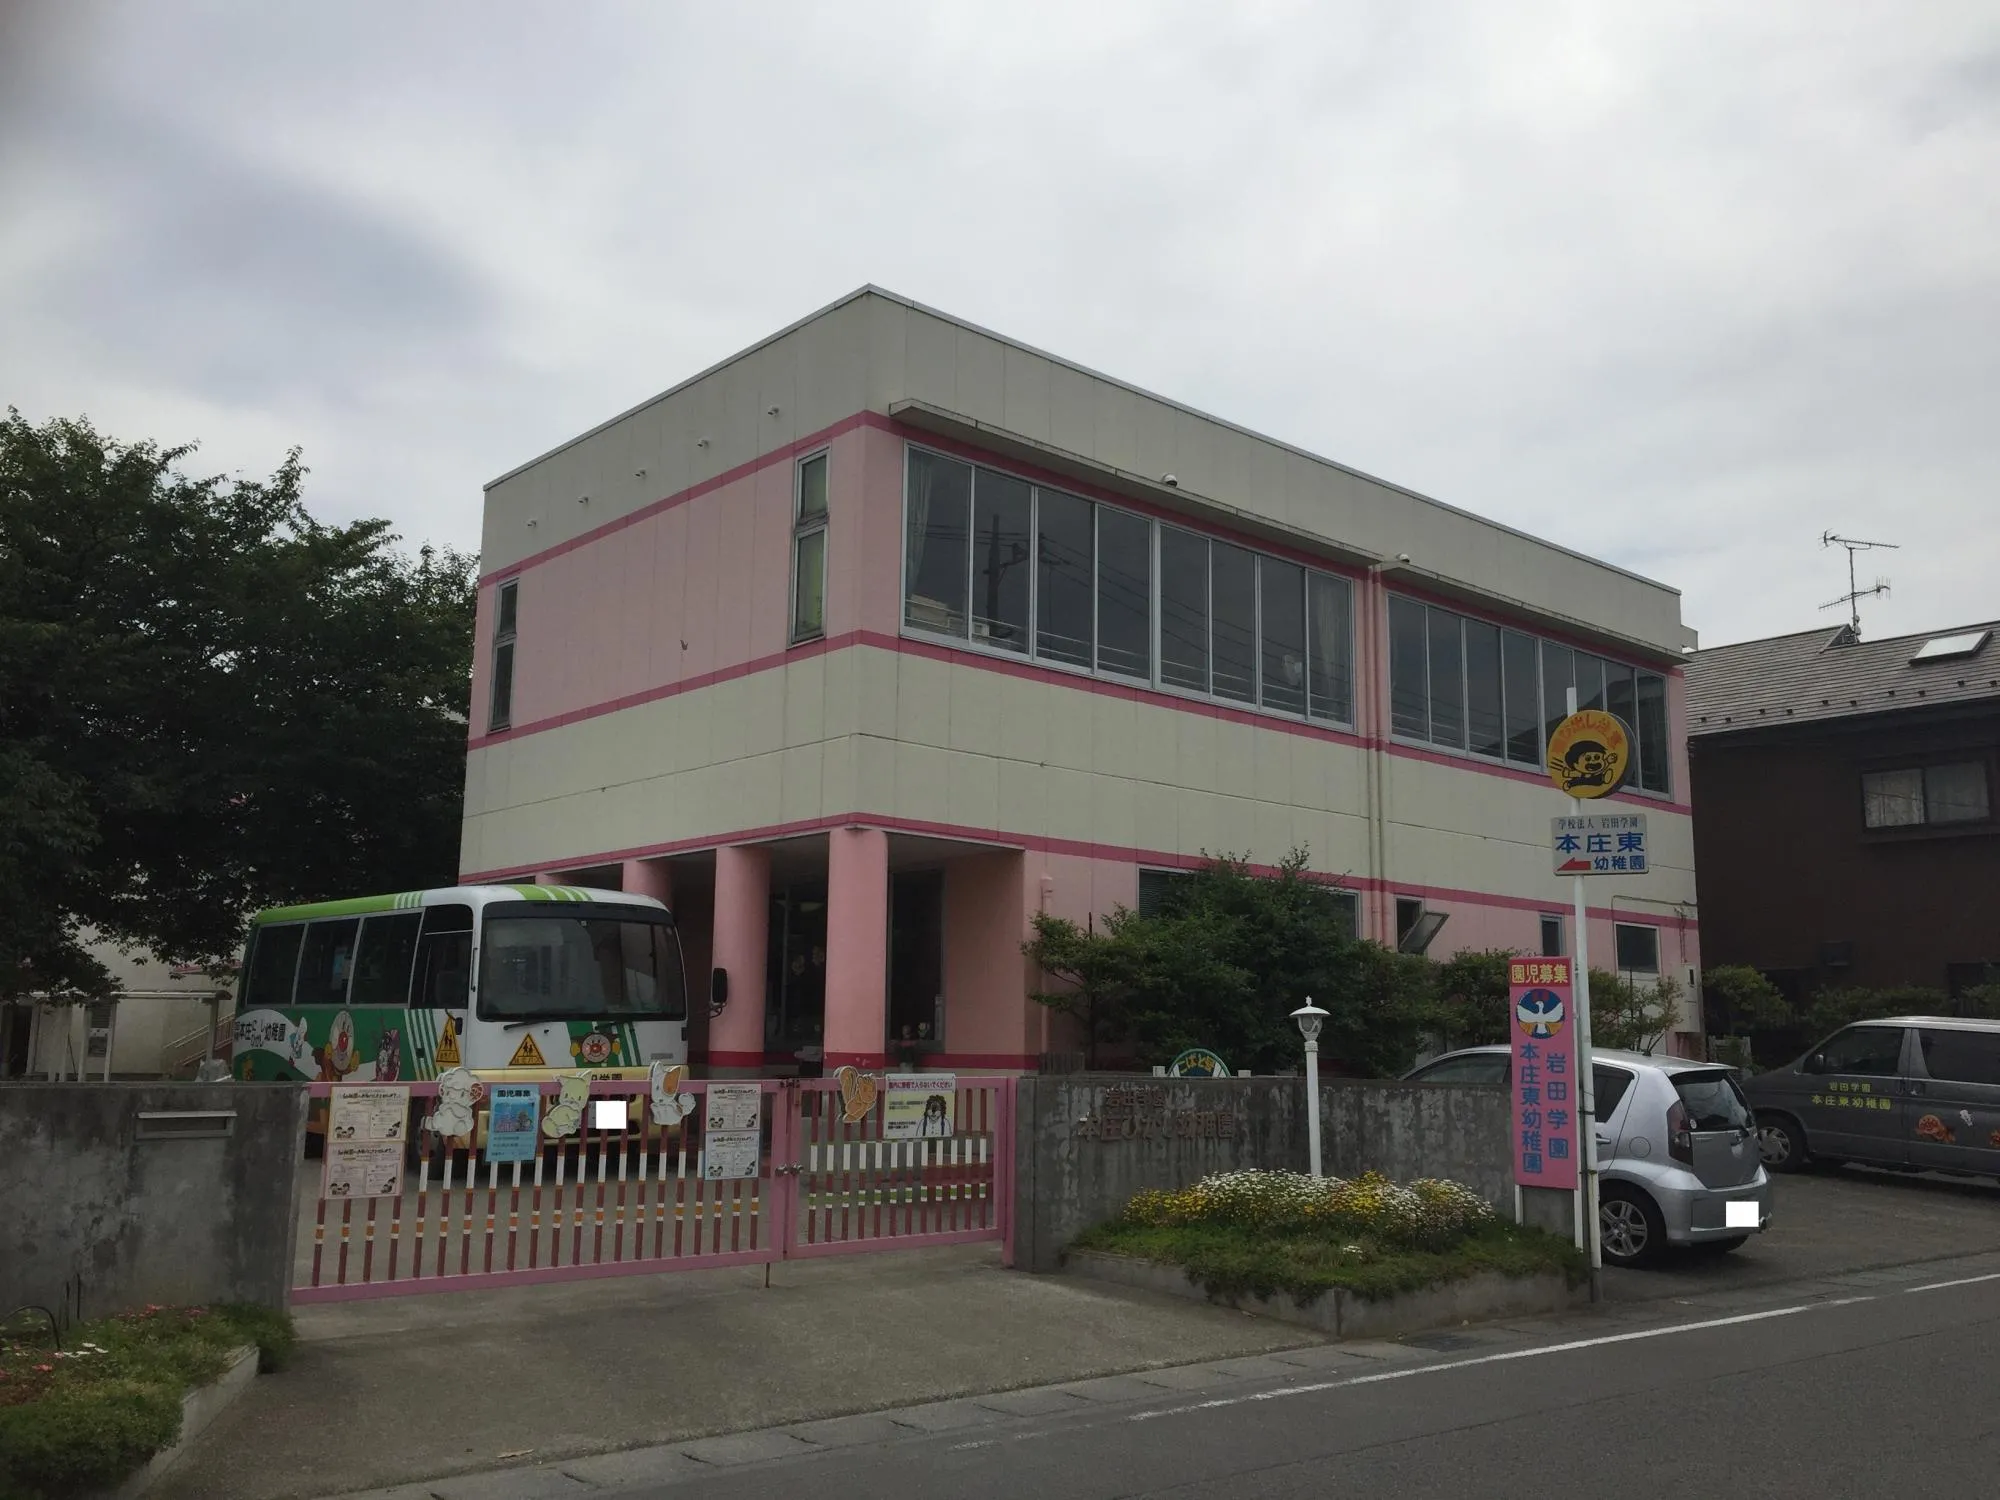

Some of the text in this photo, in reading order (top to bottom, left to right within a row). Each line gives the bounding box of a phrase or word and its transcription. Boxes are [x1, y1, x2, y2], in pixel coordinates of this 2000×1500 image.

[1559, 815, 1638, 831] 学校法人 岩田学園
[1555, 831, 1645, 854] 本庄東
[1594, 854, 1645, 871] 幼稚園
[1511, 963, 1568, 984] 園児募集
[497, 1089, 531, 1097] 園児募集
[1829, 1081, 1872, 1093] 岩田学園
[1519, 1042, 1543, 1175] 本庄東幼稚園
[1546, 1052, 1569, 1159] 岩田学園
[1811, 1094, 1892, 1111] 本庄東幼稚園
